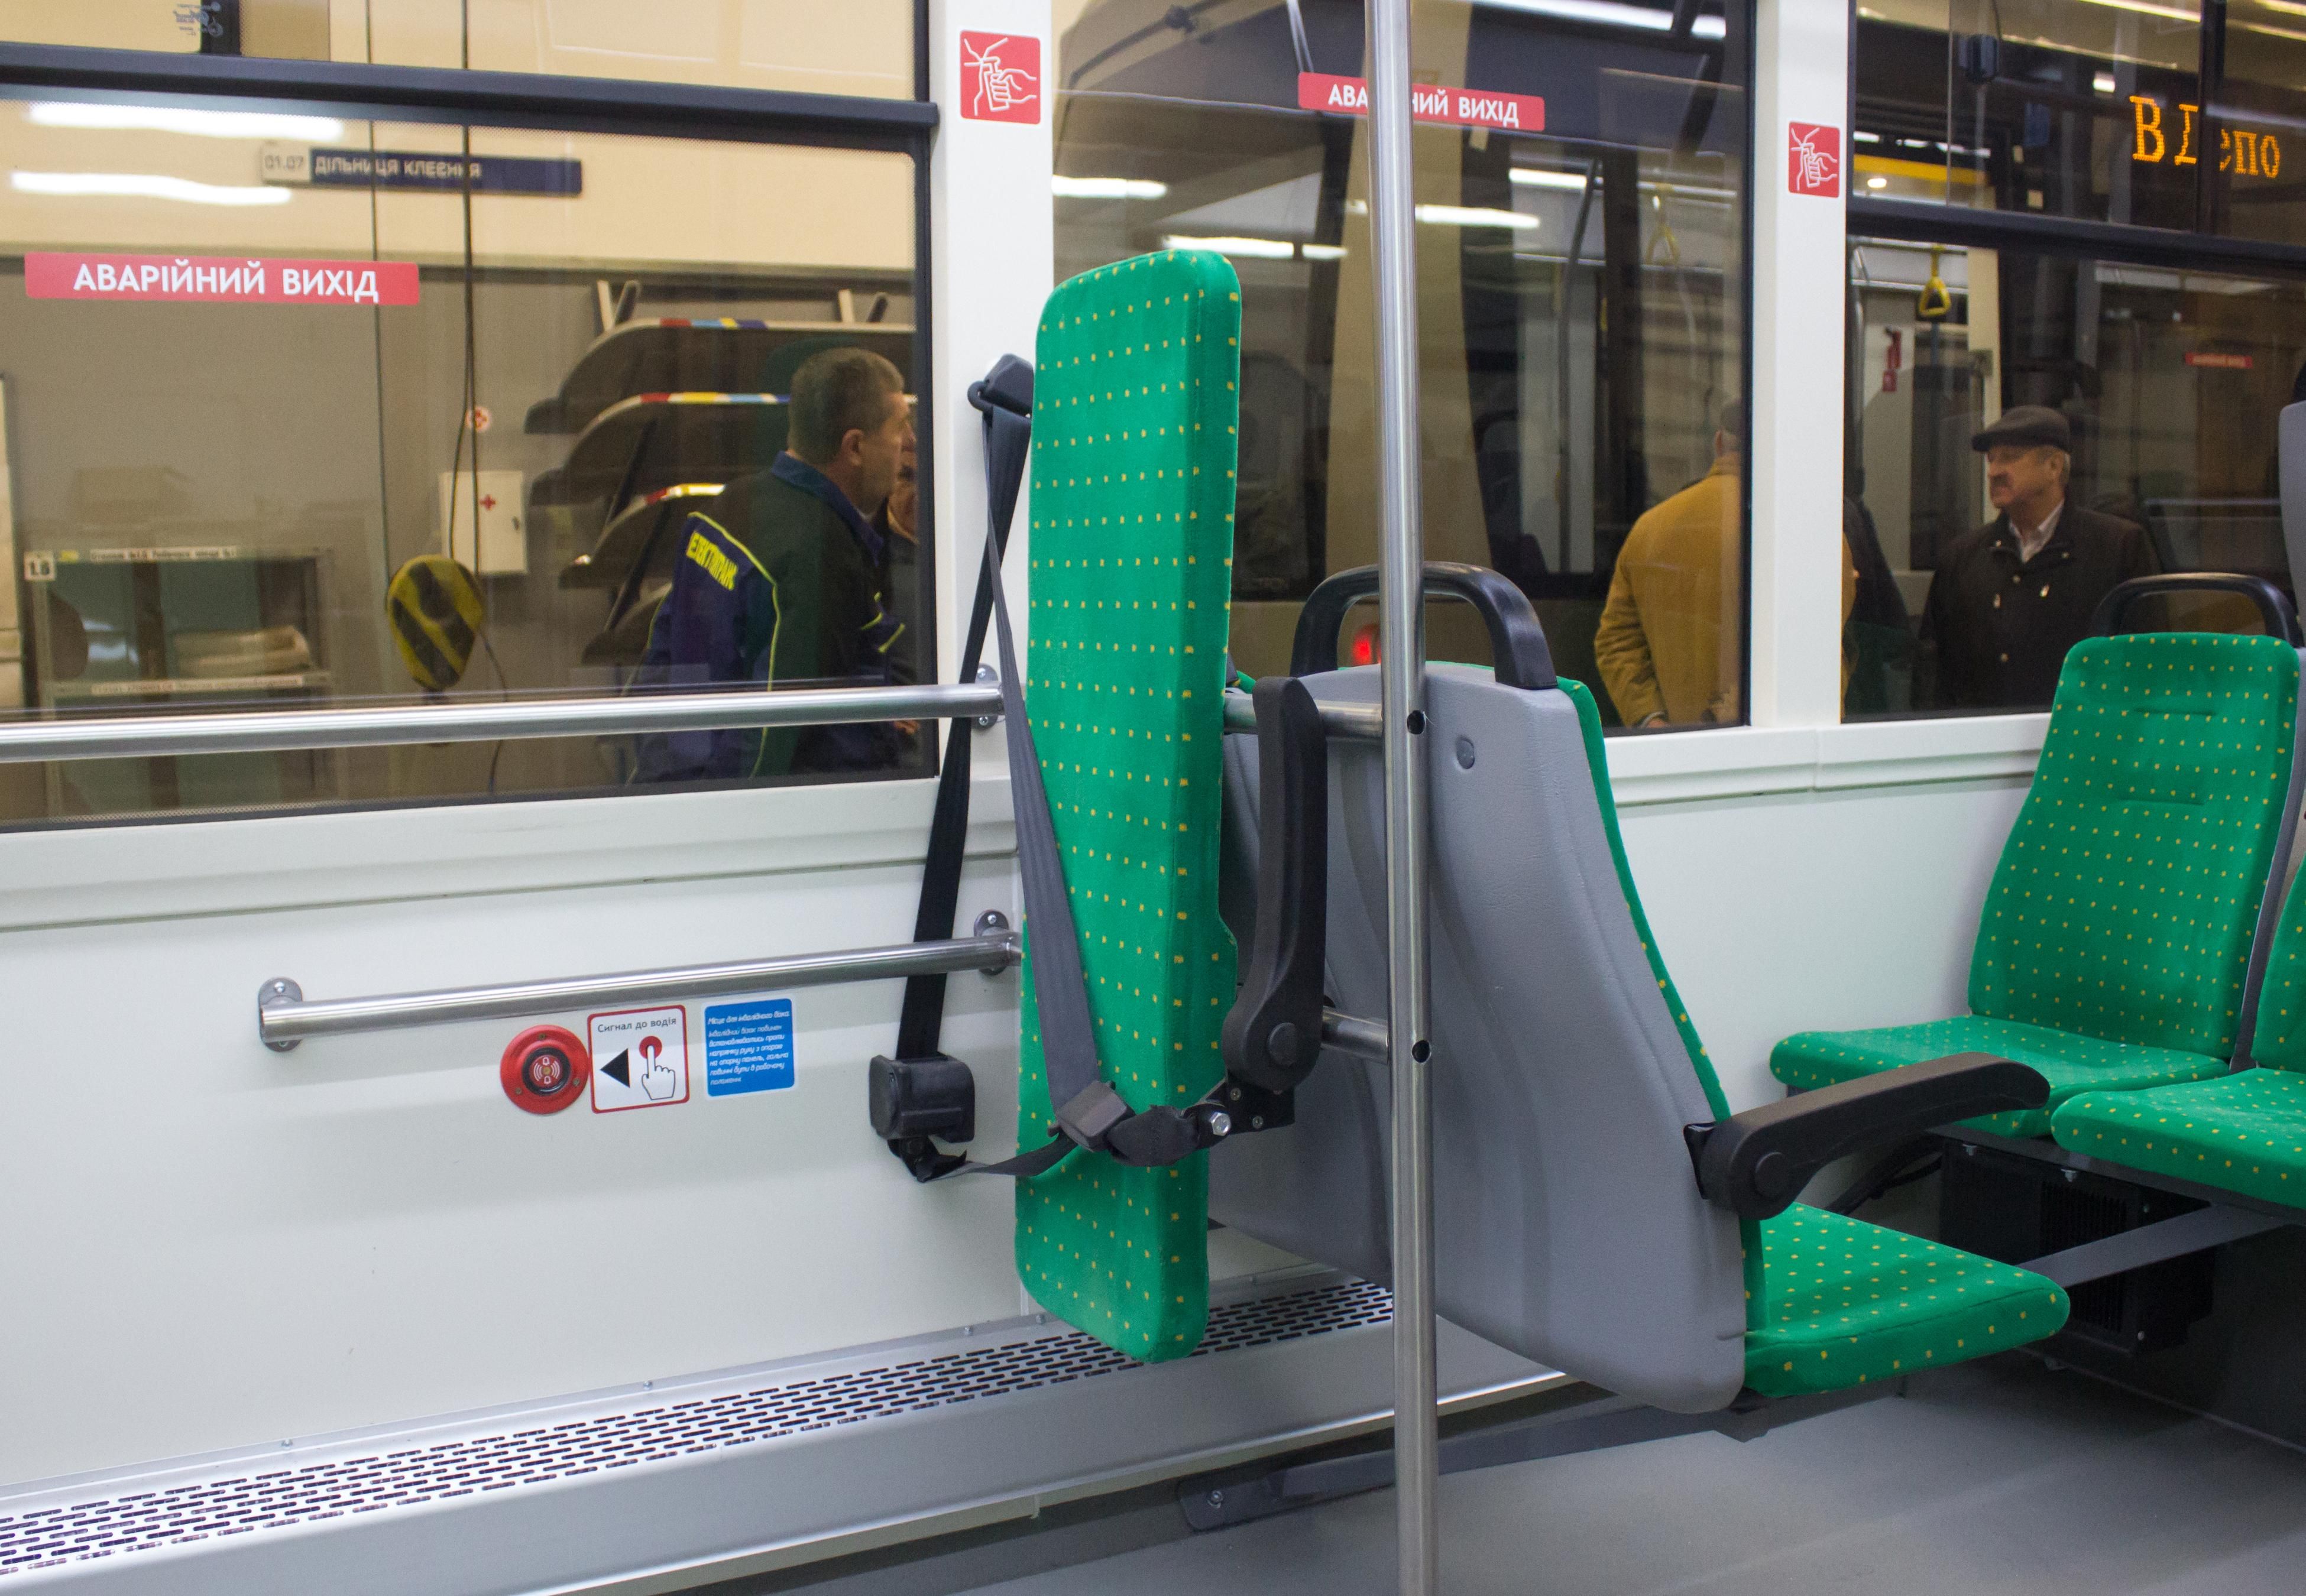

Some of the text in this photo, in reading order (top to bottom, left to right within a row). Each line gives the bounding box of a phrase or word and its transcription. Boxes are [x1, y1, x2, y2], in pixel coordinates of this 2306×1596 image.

[1458, 96, 1520, 128] ВИХІД
[2129, 95, 2166, 163] В
[73, 258, 379, 304] АВАРІЙНИЙ ВИХІД
[598, 1017, 676, 1033] Сигнал до водія
